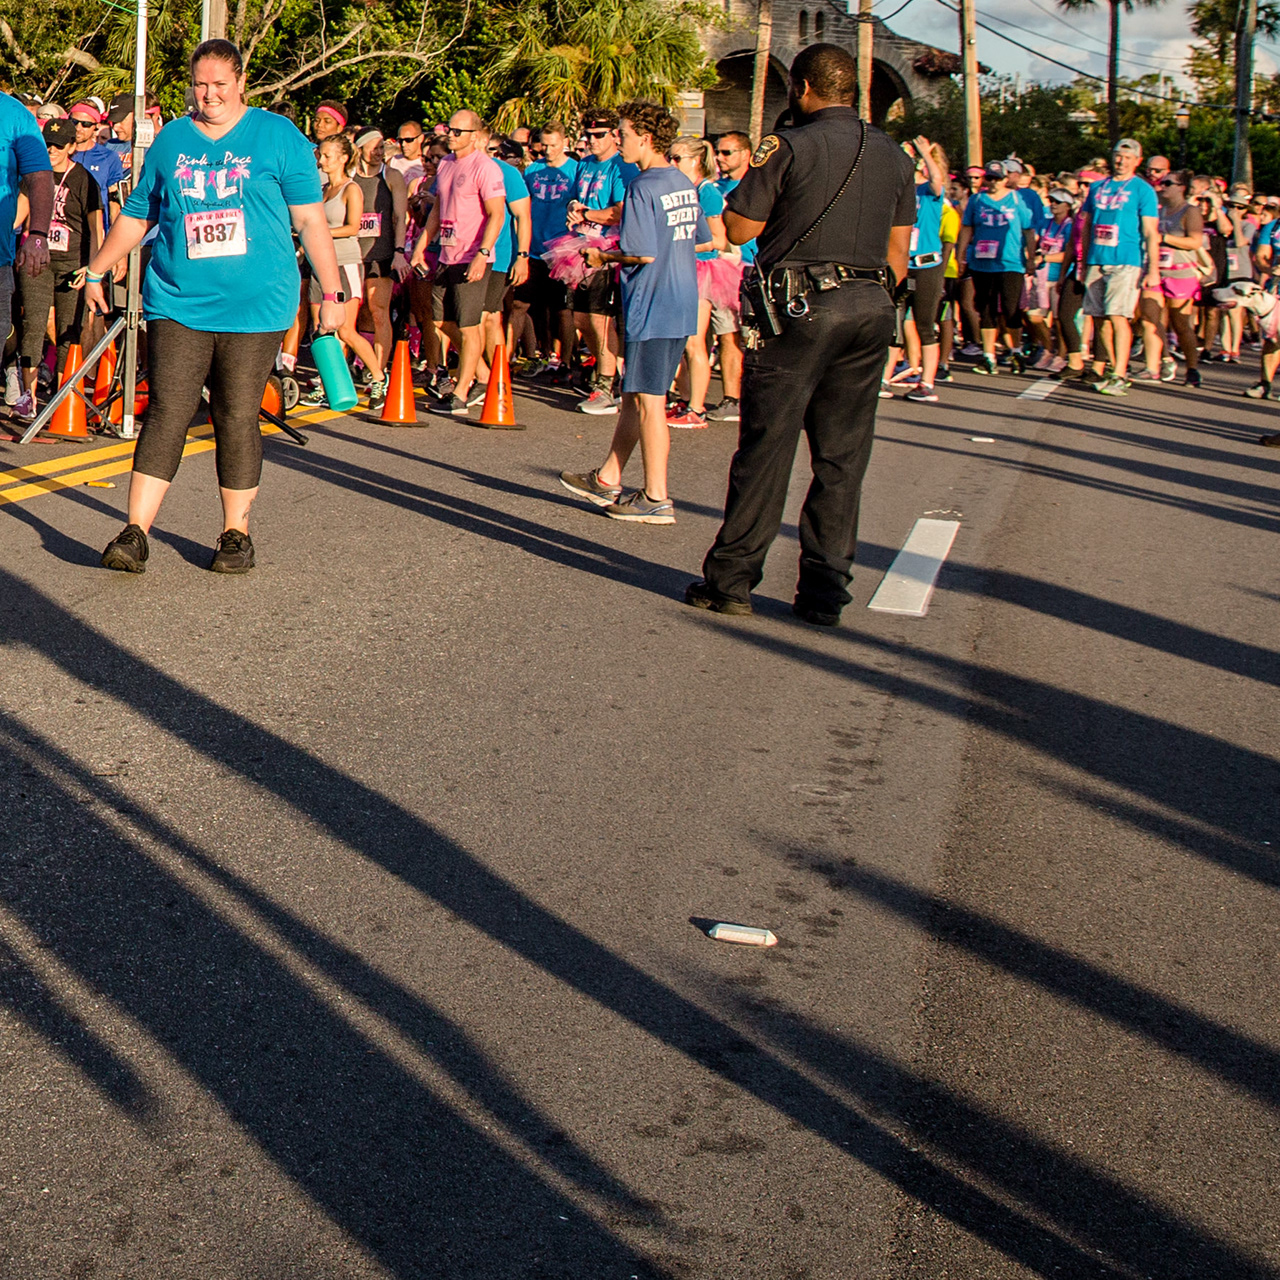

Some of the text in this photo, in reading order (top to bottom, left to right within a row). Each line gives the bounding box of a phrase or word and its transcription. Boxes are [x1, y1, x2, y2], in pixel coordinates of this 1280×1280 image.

[177, 153, 208, 166] Pink
[224, 151, 252, 165] Pace
[660, 189, 698, 211] BETTE
[192, 222, 238, 245] 1837
[673, 224, 697, 241] DAY
